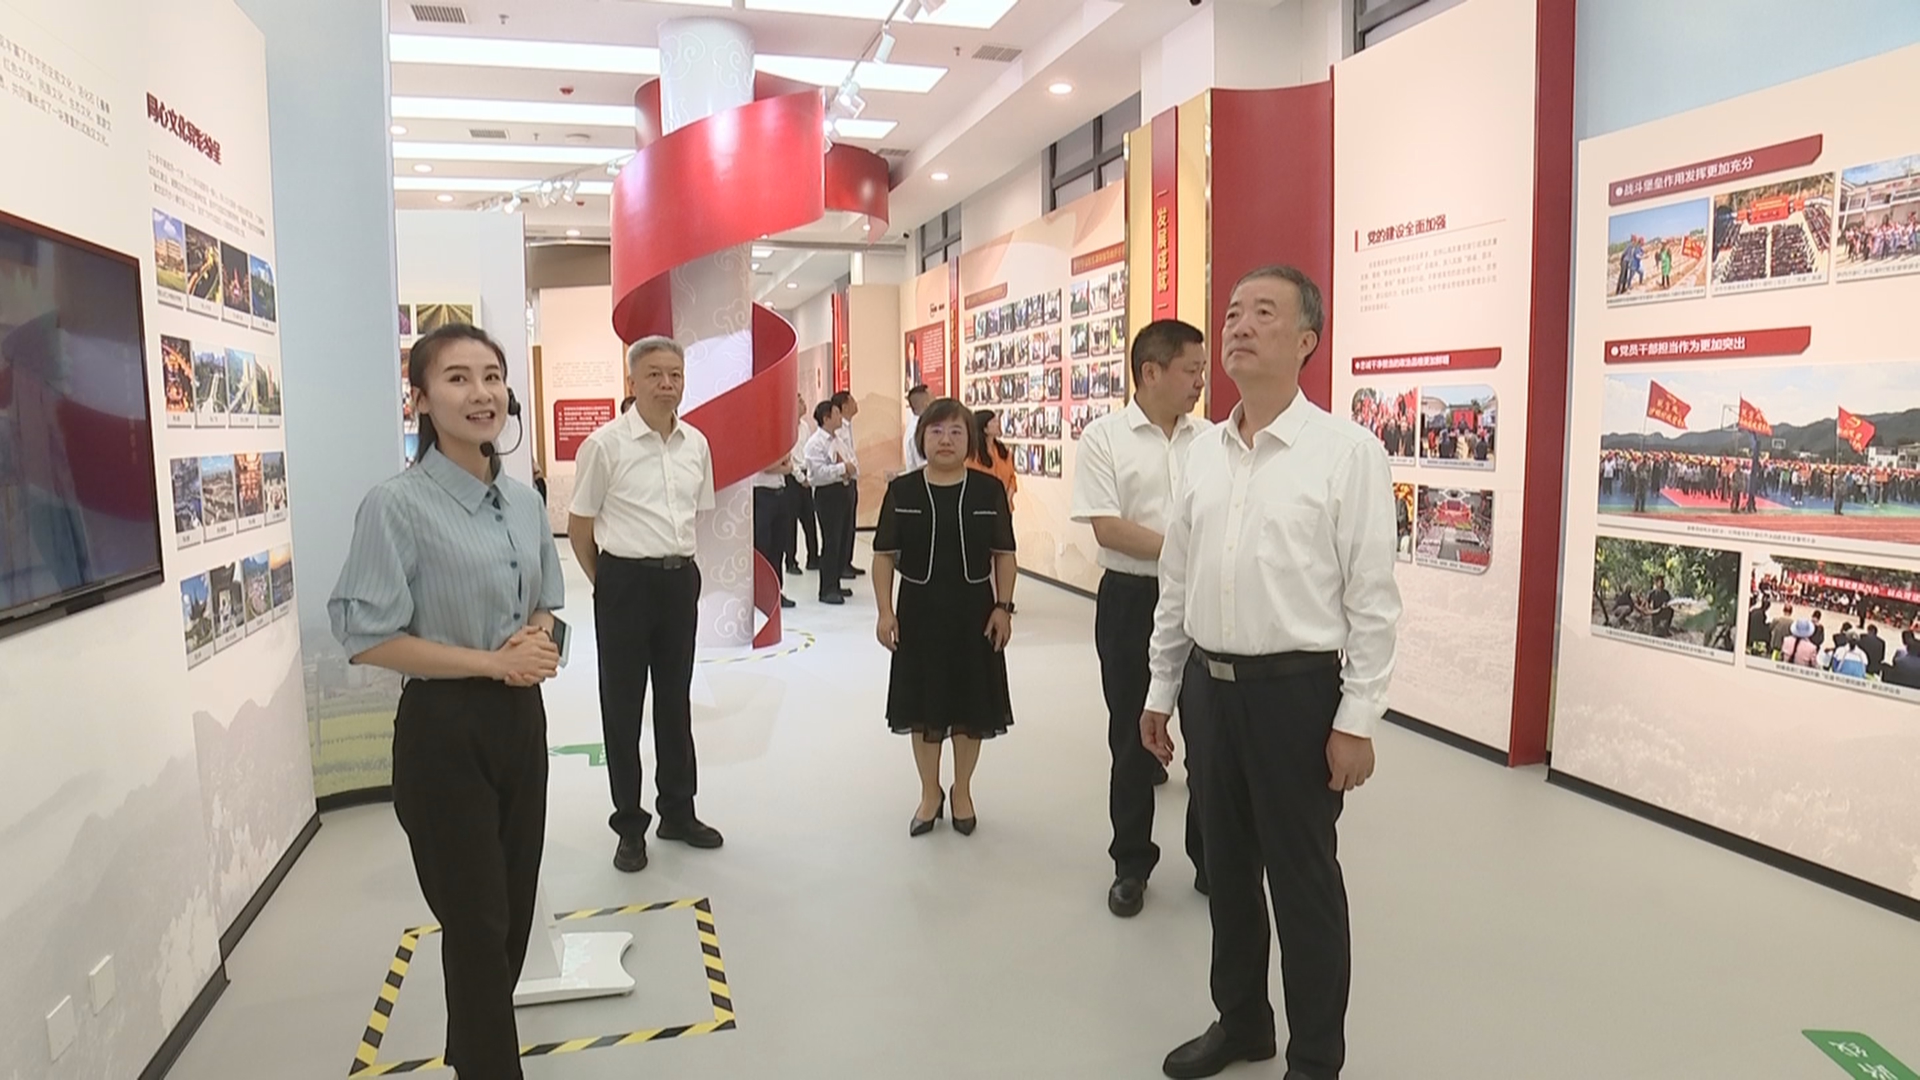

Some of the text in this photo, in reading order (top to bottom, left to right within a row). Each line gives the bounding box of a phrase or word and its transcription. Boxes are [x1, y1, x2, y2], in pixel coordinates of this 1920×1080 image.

[1624, 156, 1754, 196] 战斗堡垒作用发挥更加充分
[1367, 214, 1446, 246] 党的建设全面加强
[1156, 206, 1169, 293] 发展成就
[1619, 336, 1746, 357] 党员干部担当作为更加突出
